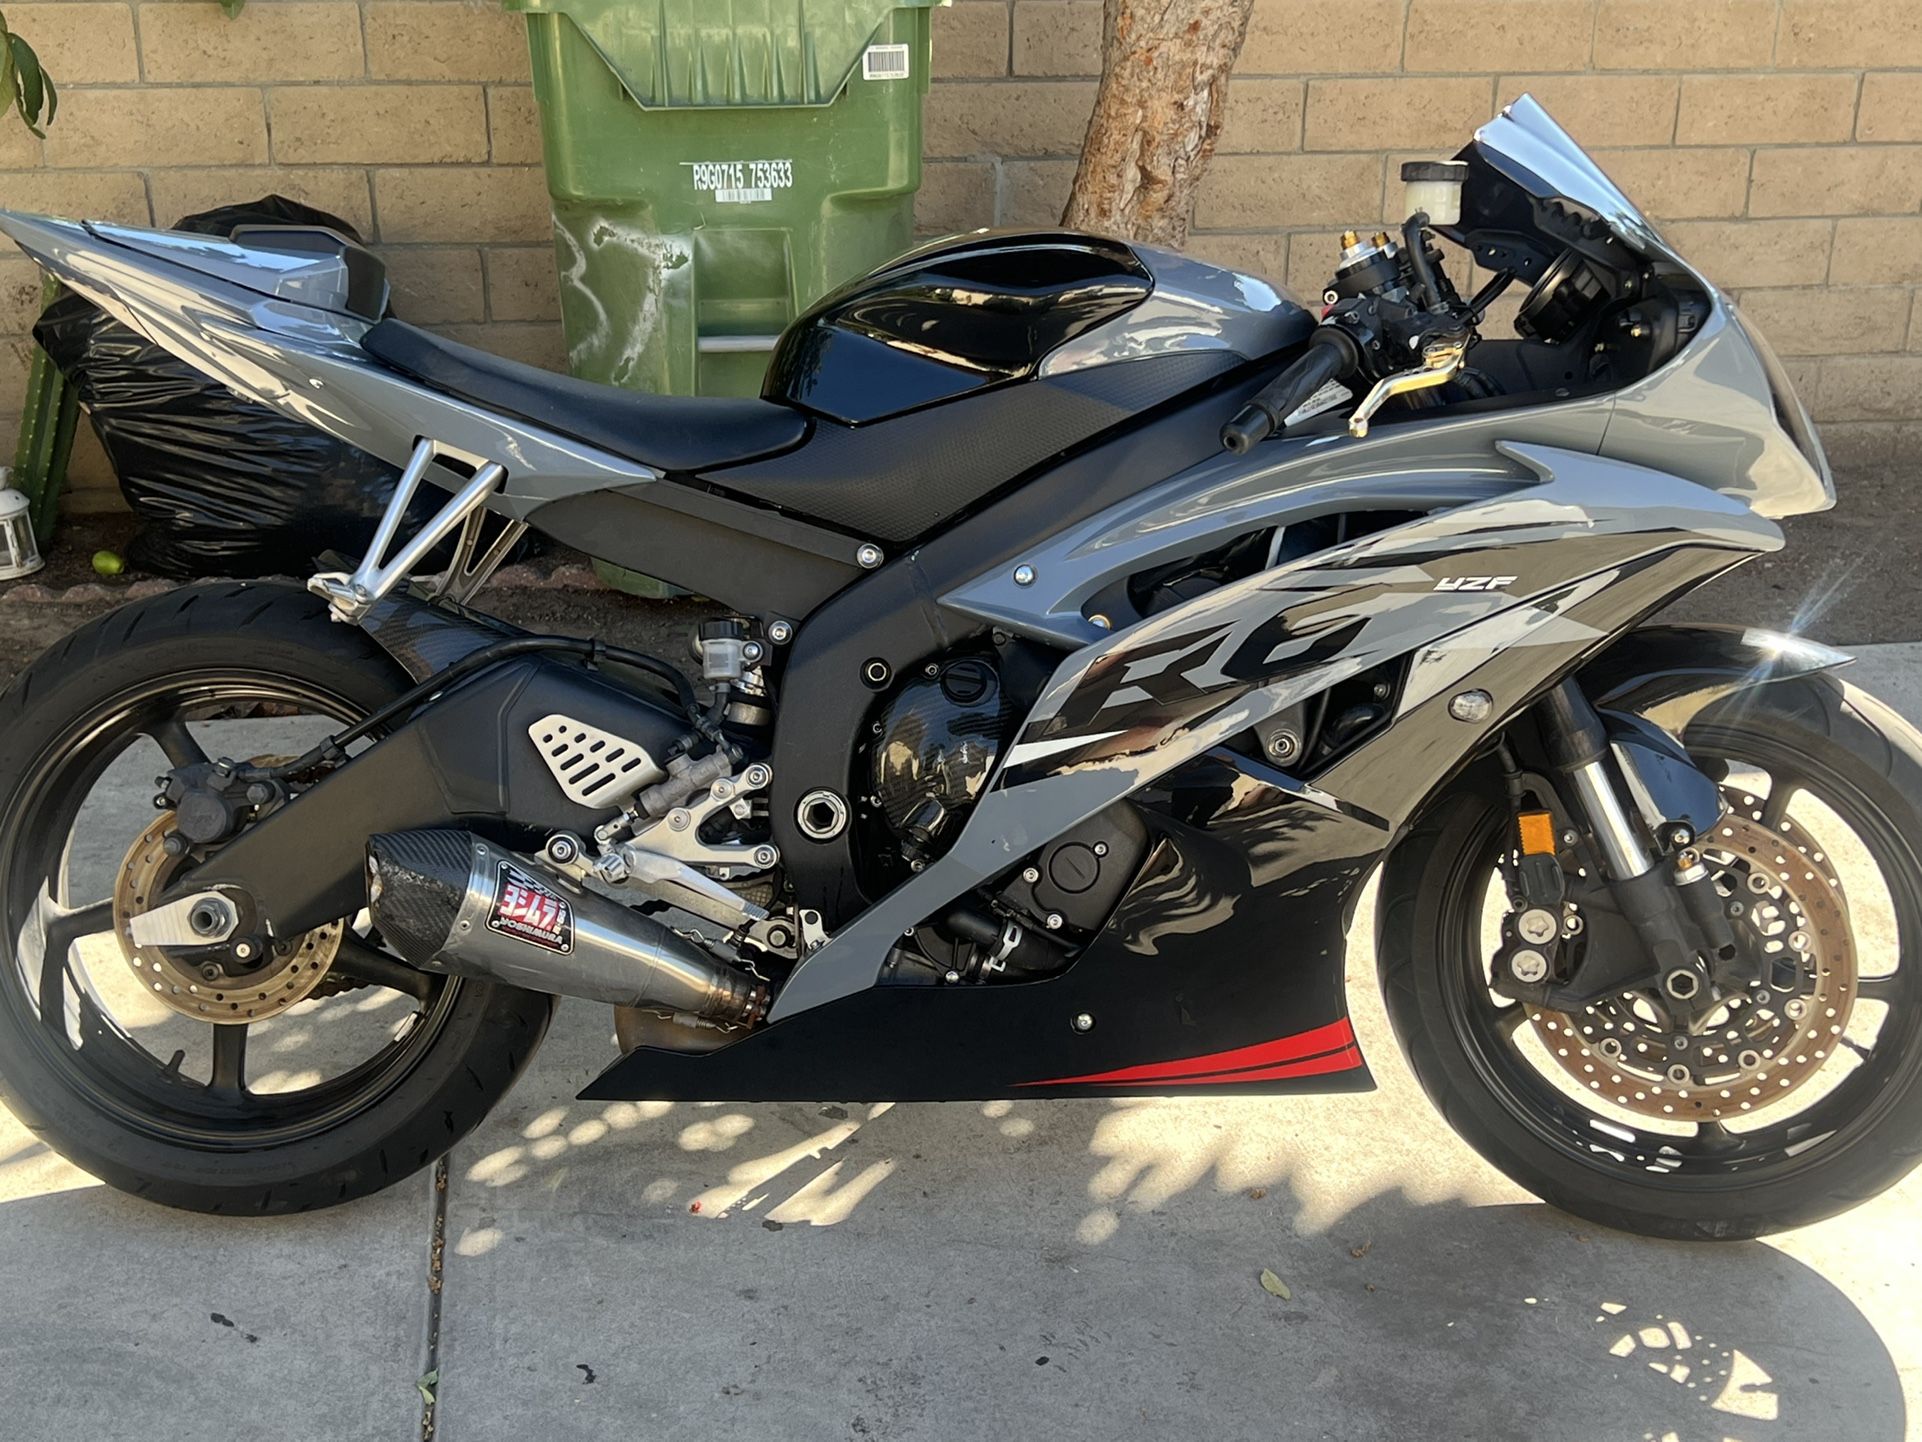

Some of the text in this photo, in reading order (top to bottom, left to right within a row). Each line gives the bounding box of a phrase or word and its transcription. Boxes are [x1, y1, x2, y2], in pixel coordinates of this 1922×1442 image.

[749, 162, 793, 188] 753633
[1433, 576, 1518, 591] YZF
[500, 916, 563, 944] YOSHIMURA
